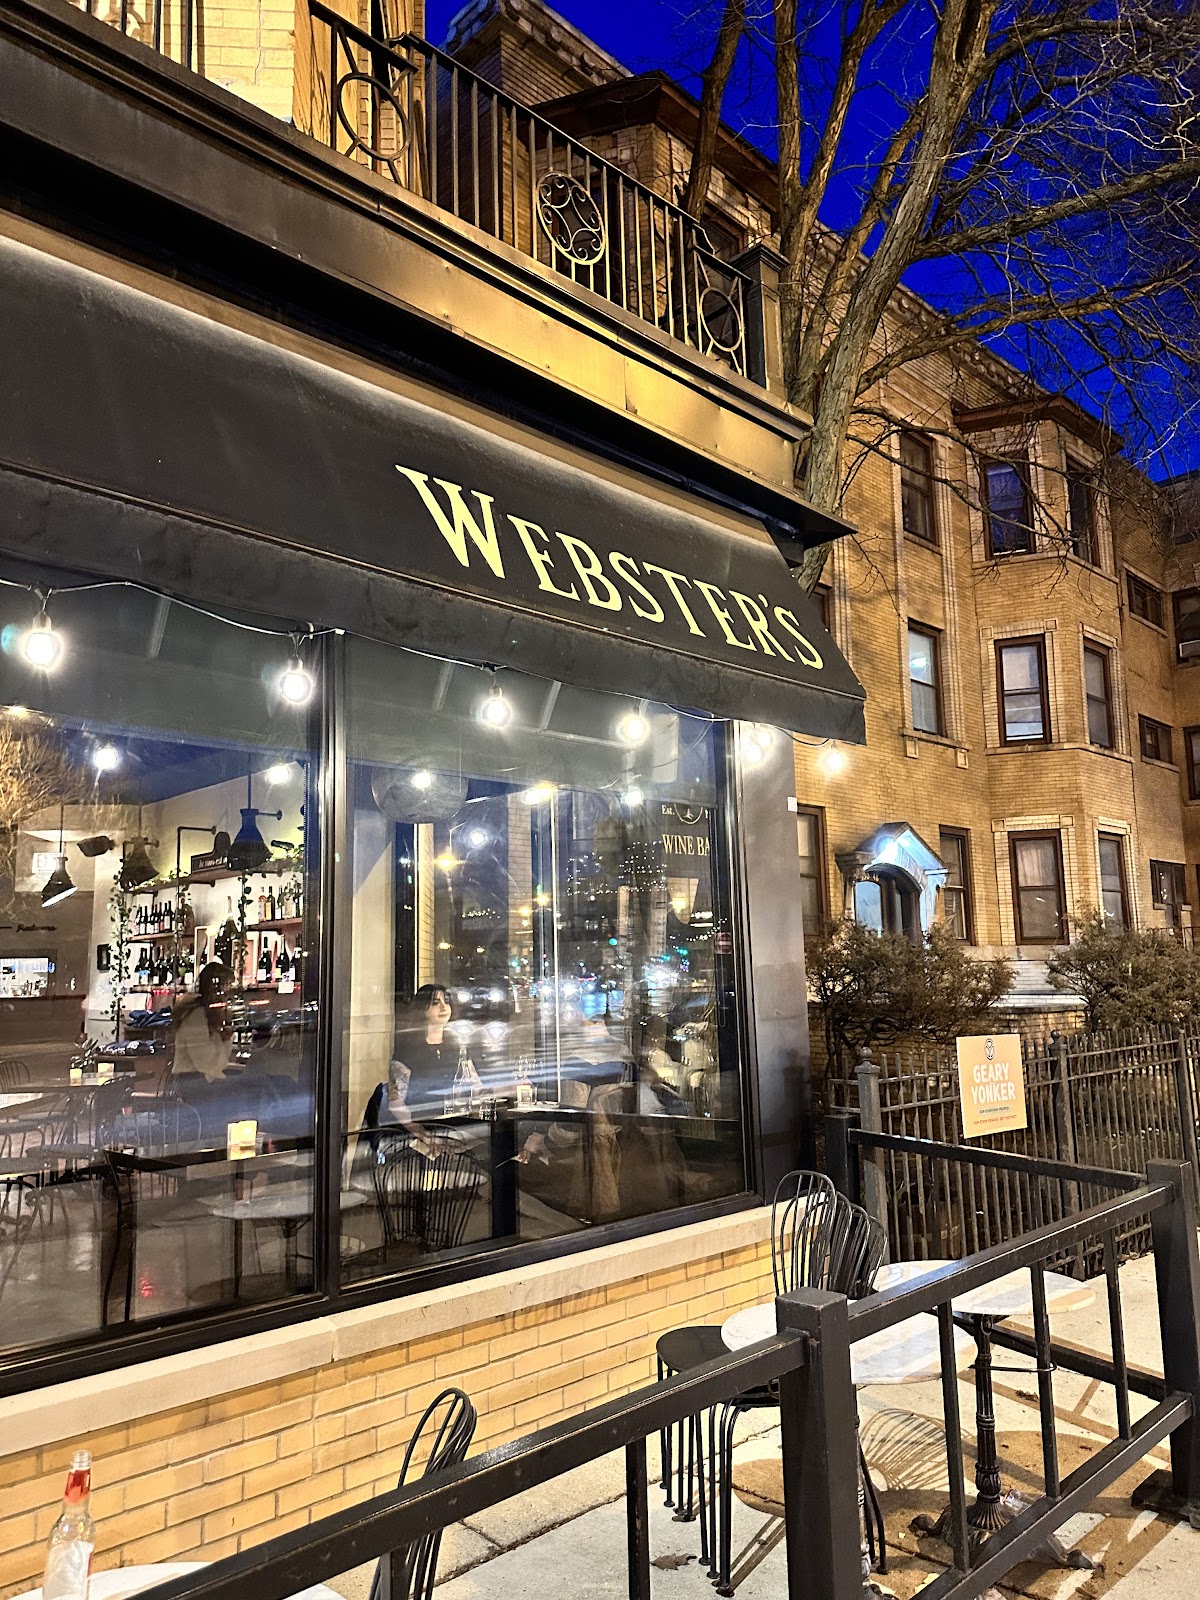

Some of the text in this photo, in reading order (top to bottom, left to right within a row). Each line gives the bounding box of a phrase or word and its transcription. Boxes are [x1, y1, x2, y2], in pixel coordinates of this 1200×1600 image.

[395, 465, 824, 669] WEBSTER'S
[661, 804, 675, 816] Est.
[661, 834, 710, 857] WINE BA
[973, 1062, 1010, 1083] GEARY
[970, 1082, 1016, 1105] YONKER
